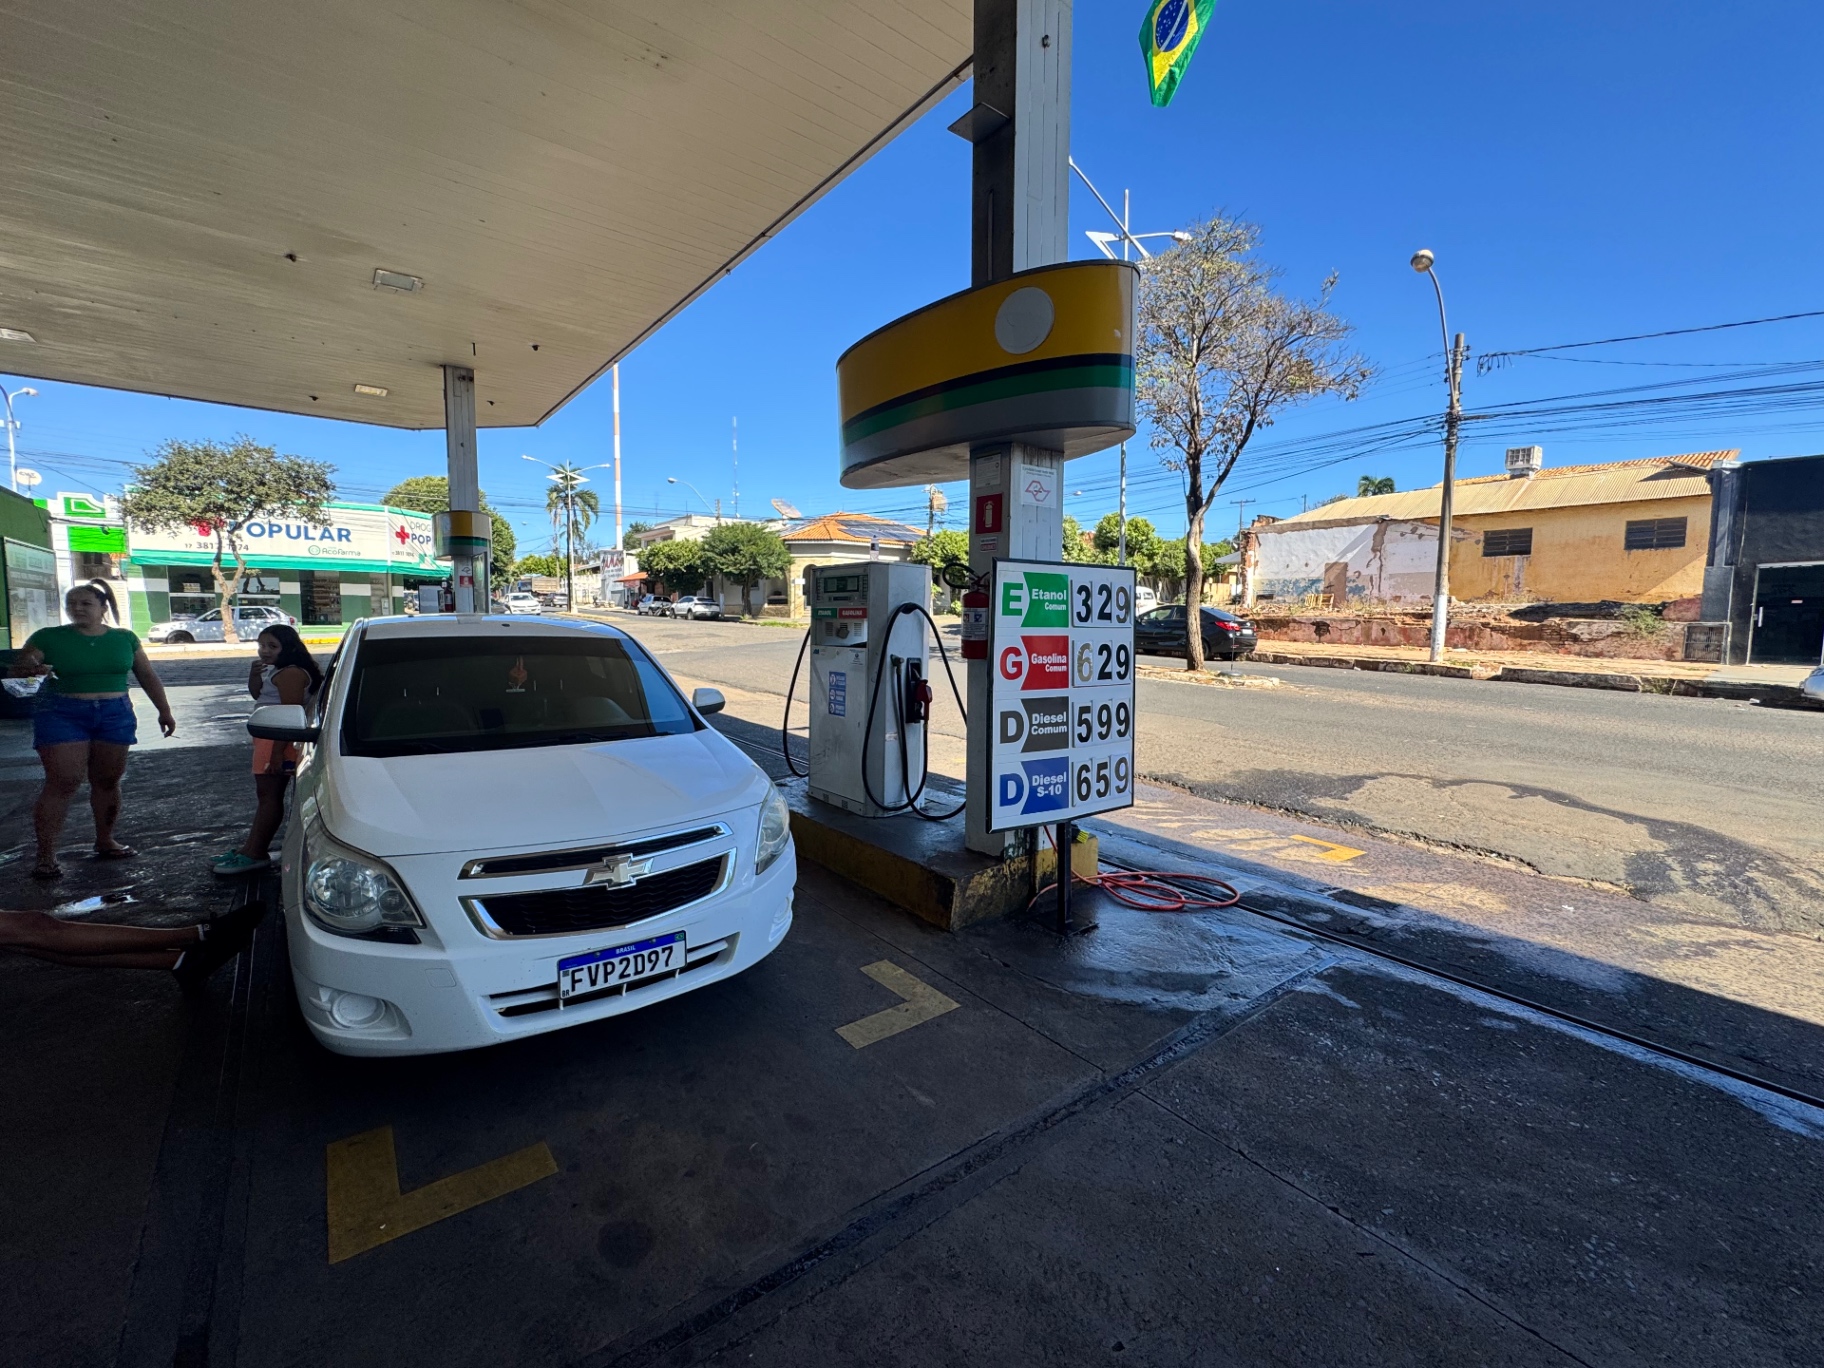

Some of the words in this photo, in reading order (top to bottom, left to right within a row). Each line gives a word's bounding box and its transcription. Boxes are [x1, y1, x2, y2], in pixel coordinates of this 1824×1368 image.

[1001, 582, 1024, 617] E
[1031, 587, 1067, 601] Etanol
[1044, 601, 1067, 611] Comum
[1000, 646, 1023, 681] G
[1031, 652, 1067, 666] Gasolina
[1044, 663, 1067, 673] Comum
[1031, 711, 1067, 726] Diesel
[1076, 701, 1130, 743] 599
[999, 710, 1025, 744] D
[1031, 724, 1068, 736] Comum
[1031, 771, 1067, 787] Diesel
[1076, 756, 1130, 802] 659
[999, 772, 1025, 807] D
[1036, 784, 1062, 798] S-10
[615, 944, 636, 955] BRASIL
[571, 945, 674, 992] FVP2D97
